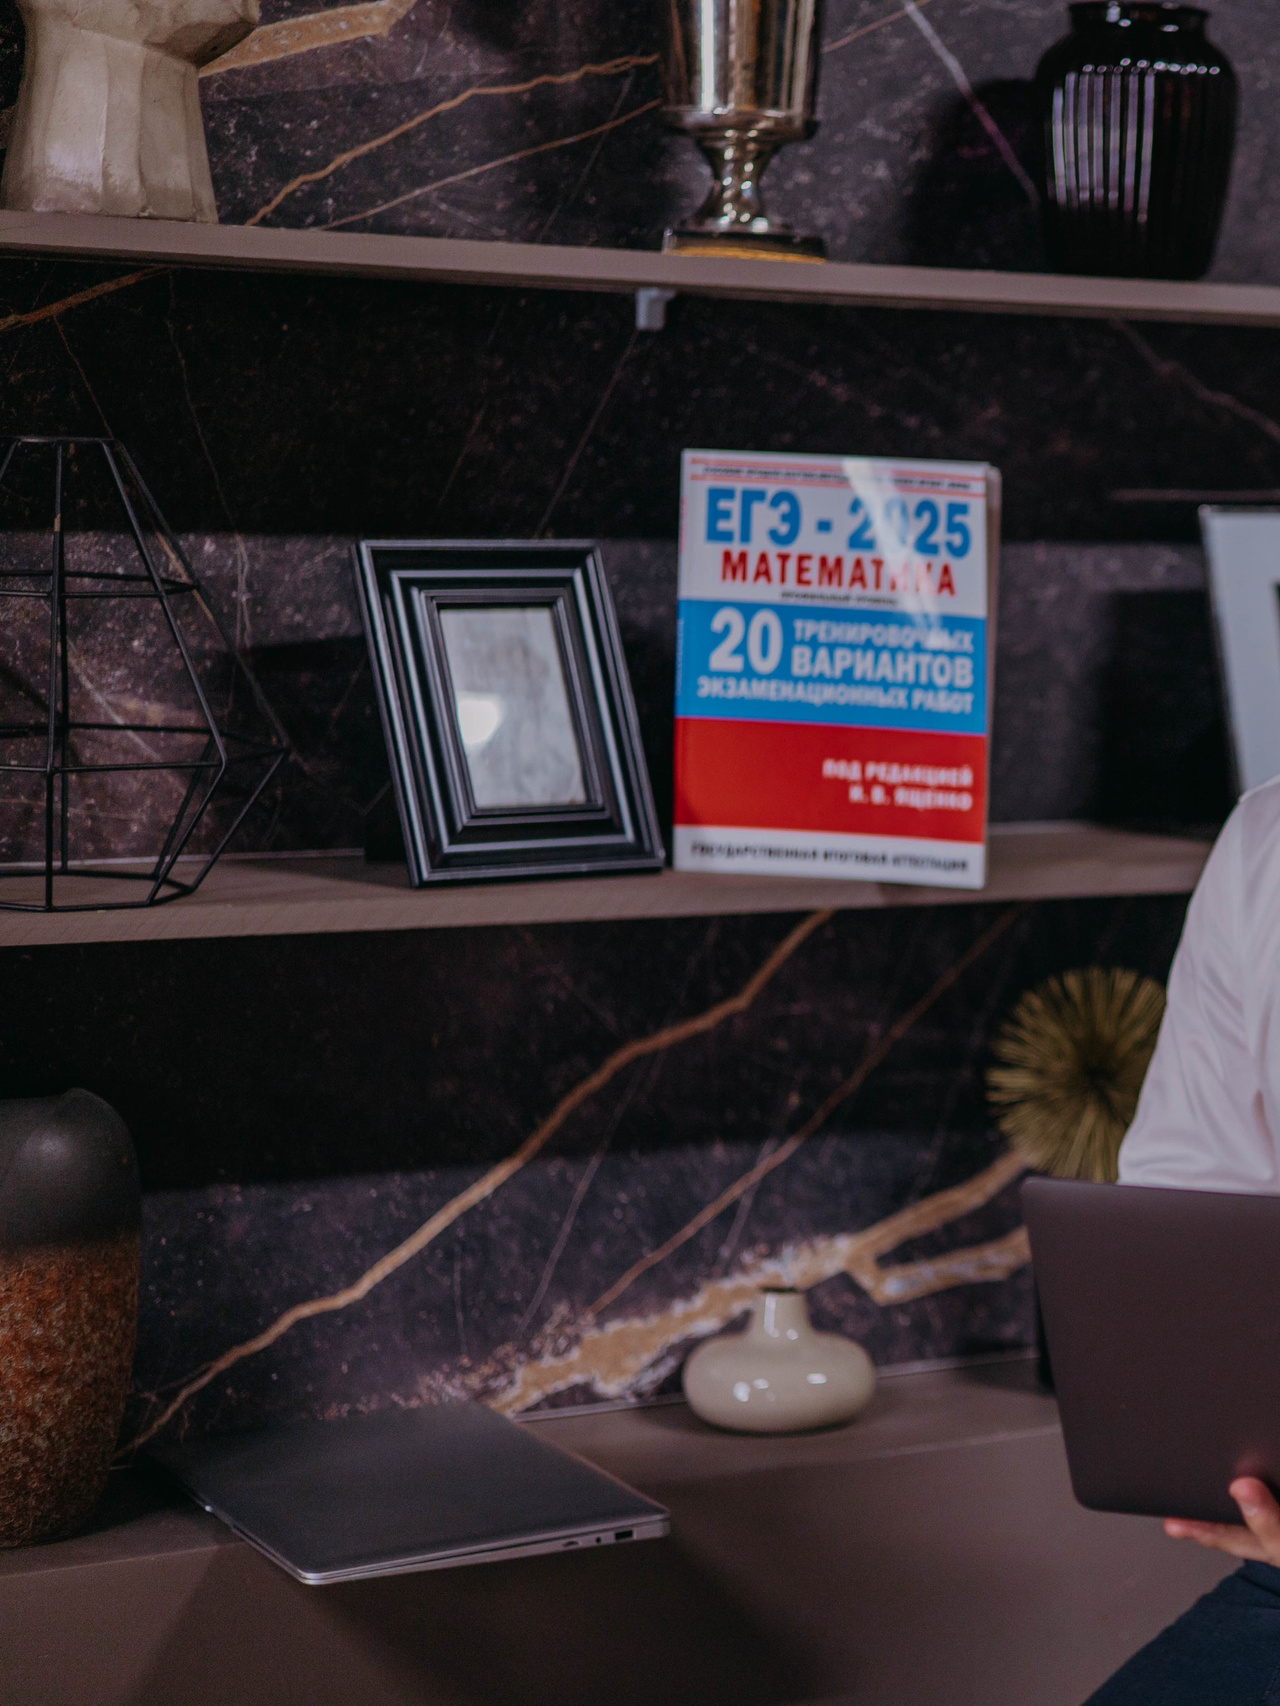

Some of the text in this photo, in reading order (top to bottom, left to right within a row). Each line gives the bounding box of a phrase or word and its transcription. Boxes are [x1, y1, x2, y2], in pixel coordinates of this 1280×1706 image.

[706, 486, 800, 546] ЕГЭ
[816, 518, 833, 533] -
[847, 496, 971, 559] 2025
[708, 606, 784, 675] 20
[791, 644, 975, 689] ВАРИАНТОВ
[696, 675, 975, 715] ЭКЗАМЕНАЦИОННЫХ РАБОТ
[822, 758, 974, 788] ПОД РЕДАКЦИЕЙ
